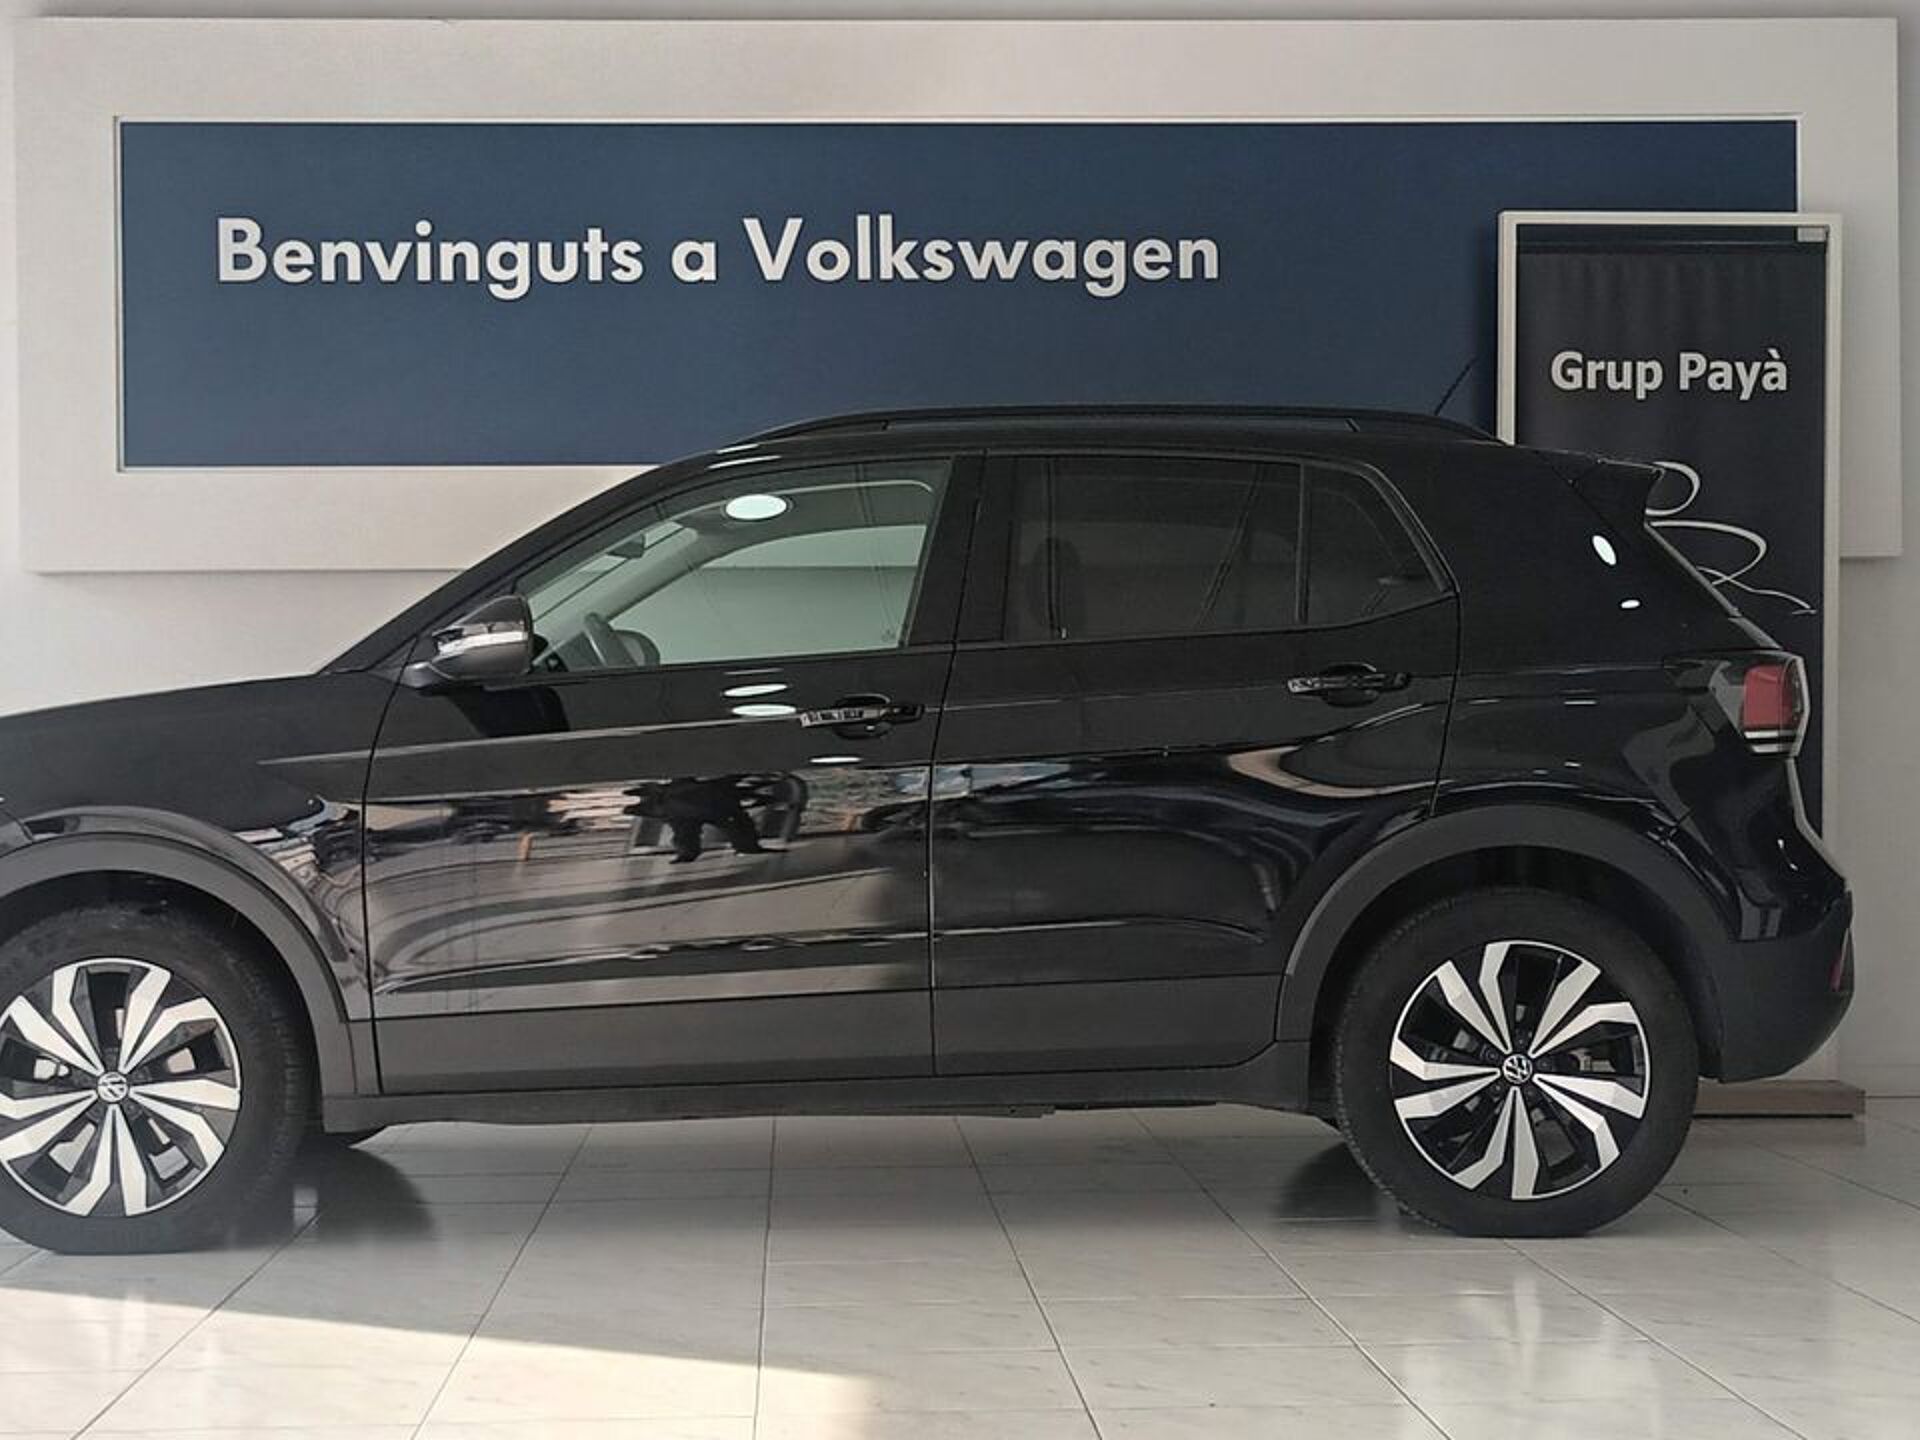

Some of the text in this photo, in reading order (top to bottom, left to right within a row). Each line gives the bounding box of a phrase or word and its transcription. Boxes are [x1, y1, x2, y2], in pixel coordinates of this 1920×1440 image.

[216, 213, 1220, 301] Benvinguts a Volkswagen
[1551, 348, 1788, 401] Grup Payà
